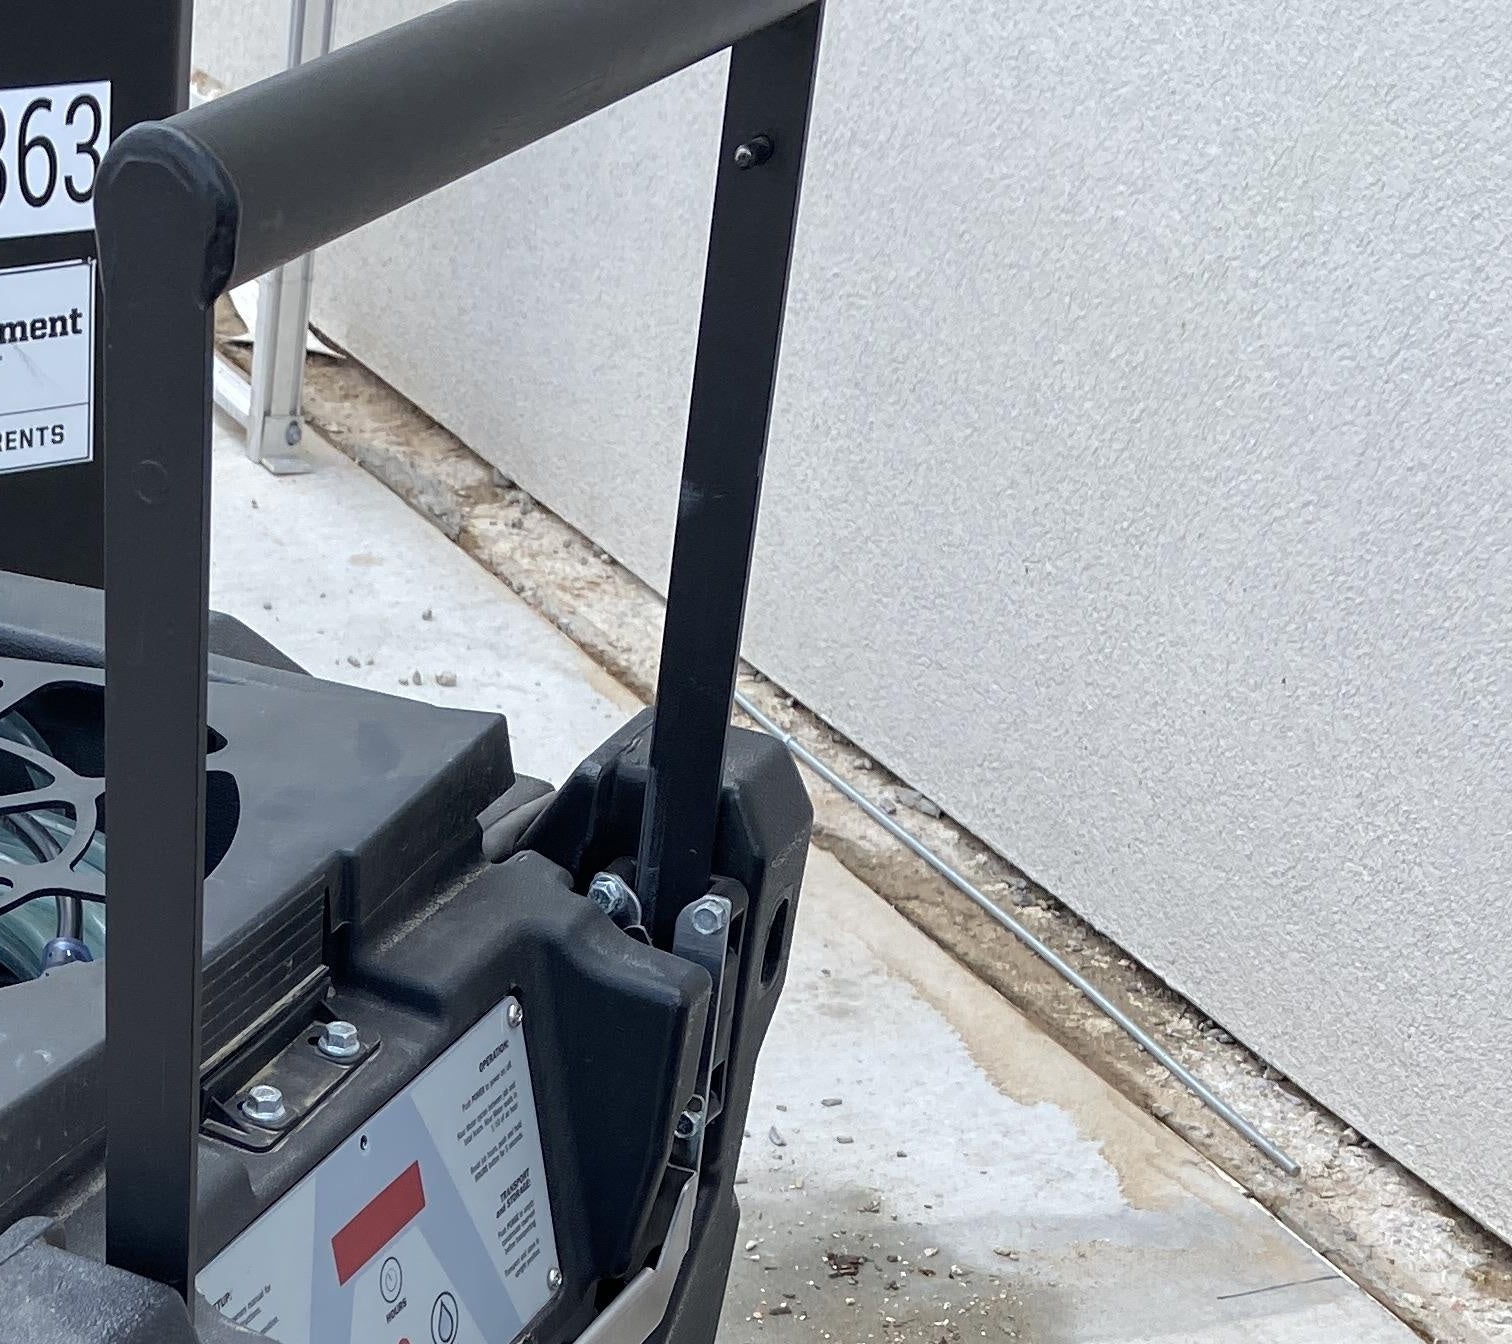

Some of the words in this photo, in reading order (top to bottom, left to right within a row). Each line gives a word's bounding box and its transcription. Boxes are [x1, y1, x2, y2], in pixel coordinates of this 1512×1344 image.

[499, 1166, 530, 1202] TRANSPORT
[212, 1288, 233, 1314] TUP:
[385, 1295, 408, 1324] HOURS
